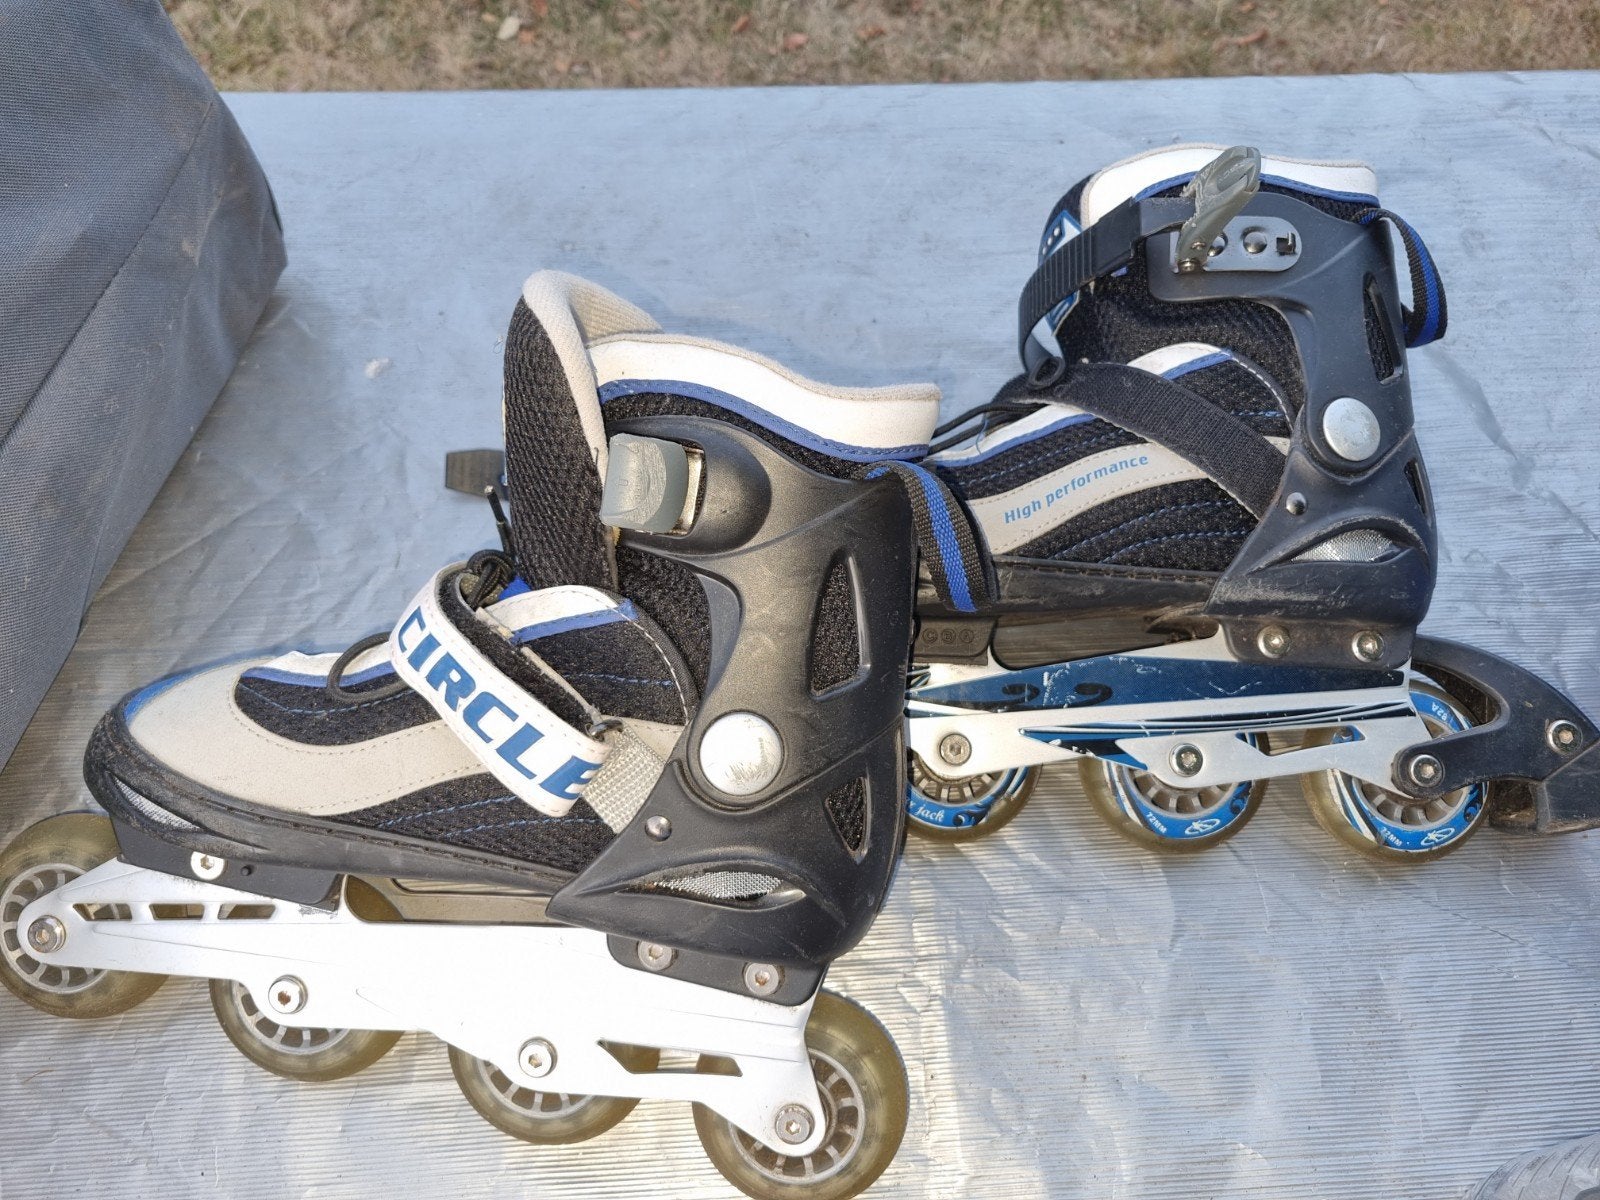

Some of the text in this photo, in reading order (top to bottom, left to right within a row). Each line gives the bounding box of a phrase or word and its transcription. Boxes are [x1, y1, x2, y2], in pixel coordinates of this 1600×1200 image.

[1005, 456, 1149, 523] High performance
[398, 606, 602, 799] CIRCLE
